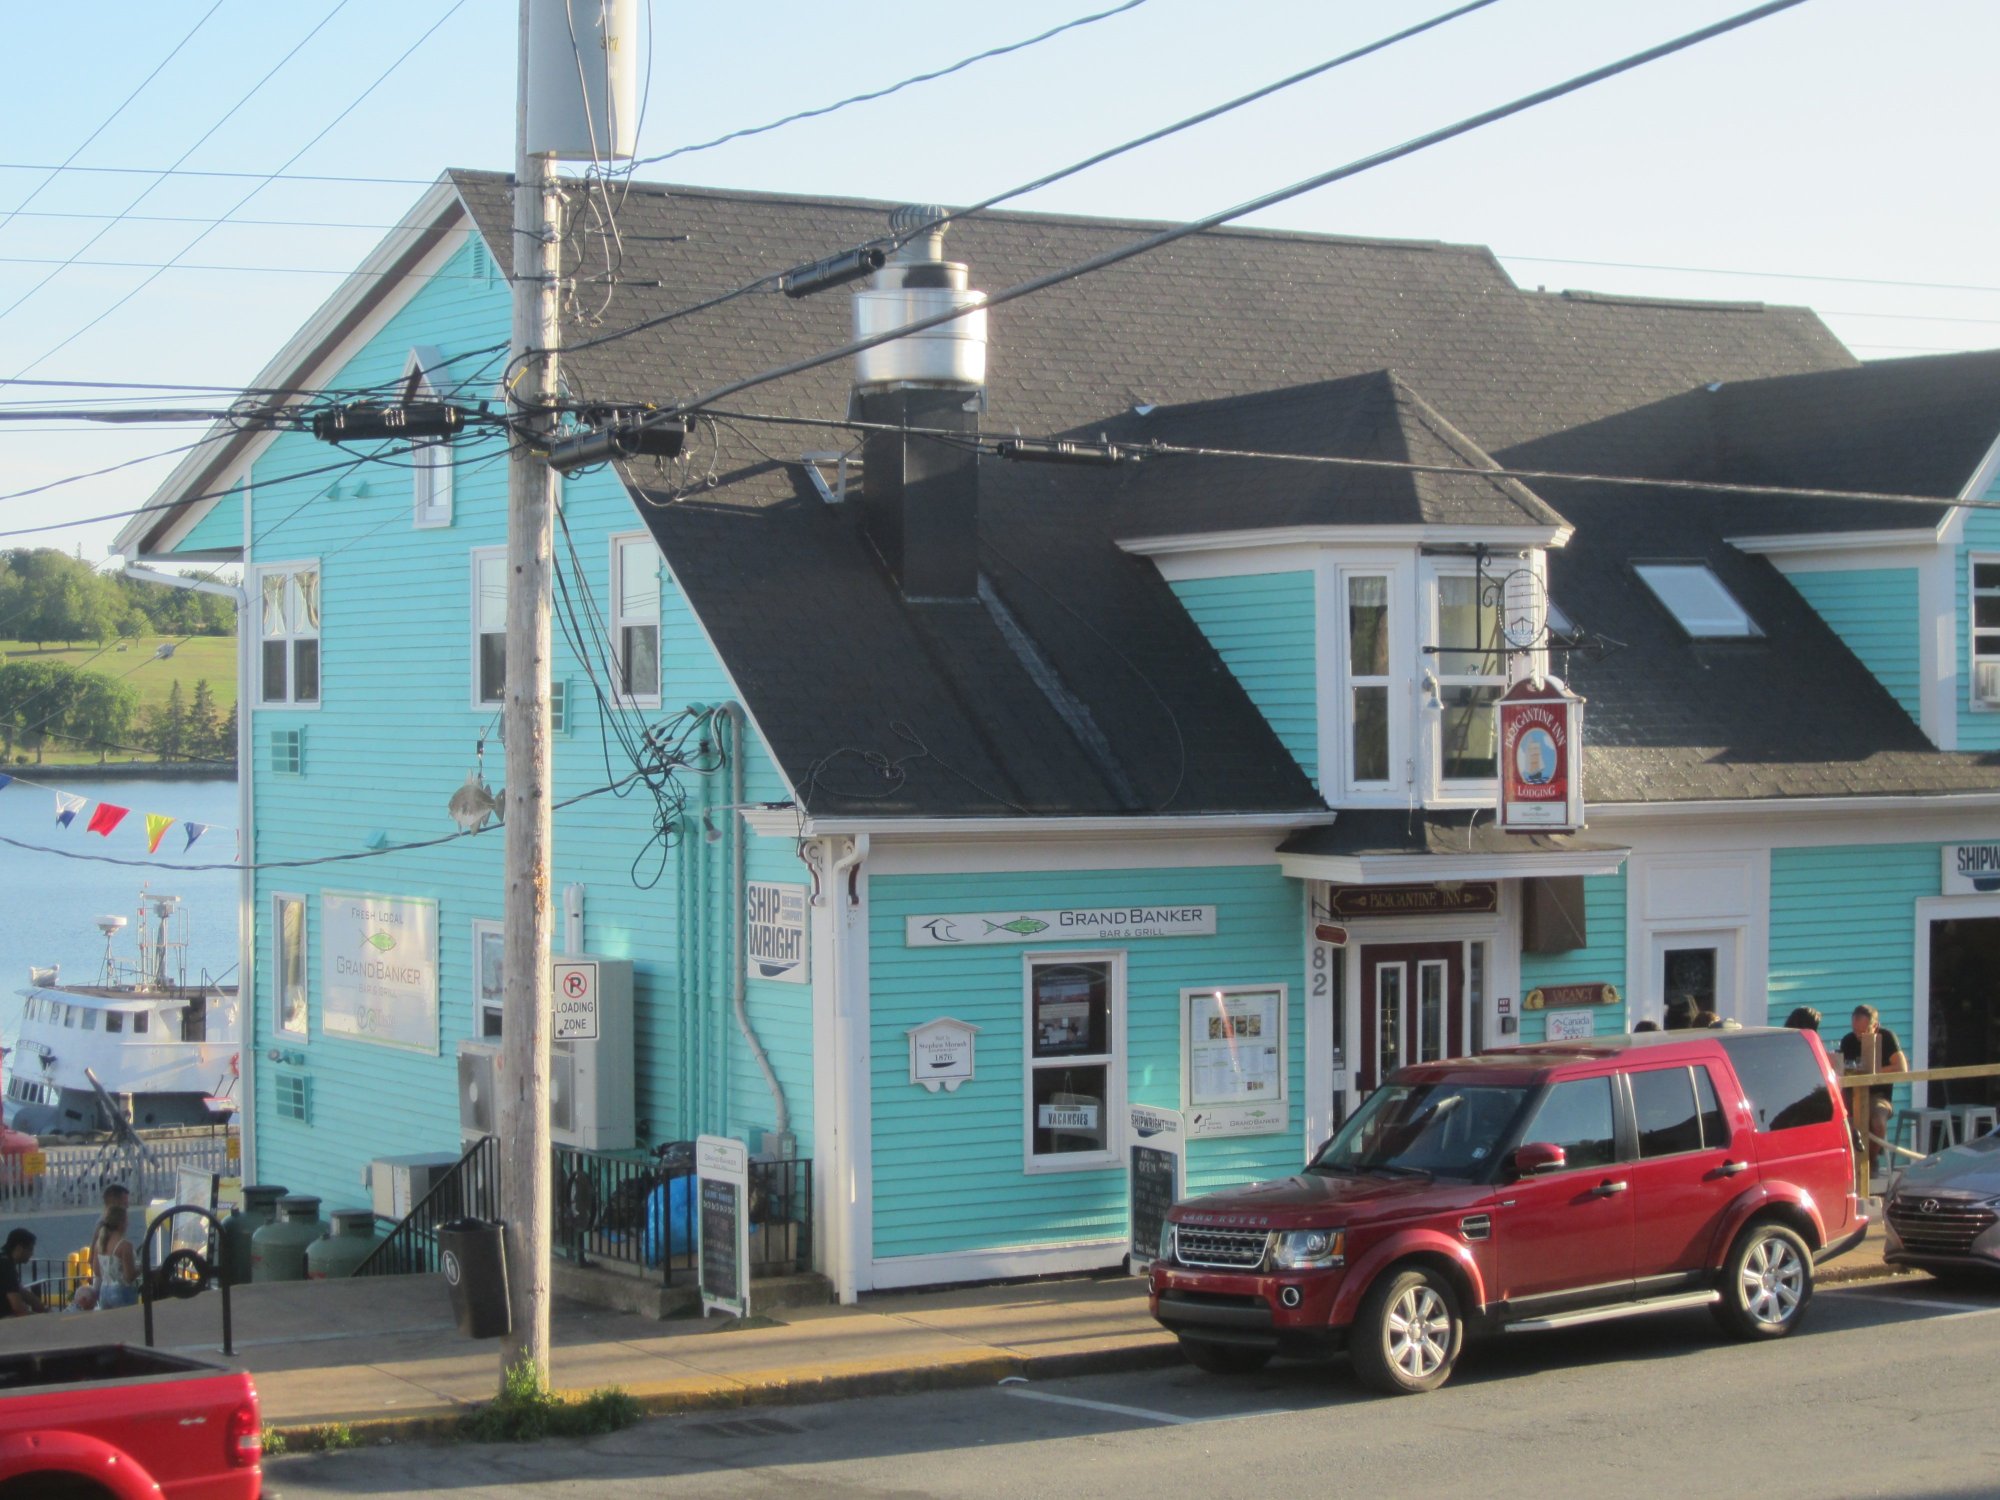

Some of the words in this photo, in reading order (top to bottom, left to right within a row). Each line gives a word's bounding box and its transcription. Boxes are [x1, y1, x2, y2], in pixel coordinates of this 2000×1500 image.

[1504, 707, 1555, 749] BRIGANTINE
[1551, 721, 1567, 747] INN
[1516, 784, 1556, 798] LODGING
[748, 885, 781, 925] SHIP
[1370, 891, 1438, 907] BRIGANTINE
[1443, 891, 1461, 906] INN
[351, 907, 376, 921] FRESH
[378, 910, 404, 925] LOCAL
[1099, 930, 1123, 938] BAR
[1124, 929, 1131, 937] &
[1134, 927, 1166, 937] GRILL
[748, 923, 803, 960] WRIGHT
[1551, 987, 1593, 1002] VACANCY
[556, 1001, 594, 1014] LOADING
[563, 1018, 588, 1030] ZONE
[1562, 1015, 1590, 1026] Canada
[1562, 1026, 1585, 1036] Select
[935, 1053, 953, 1061] 1876
[1047, 1112, 1089, 1126] VACANCIES
[1130, 1113, 1165, 1131] SHIPWRIGHT
[1182, 1212, 1213, 1222] LAND
[1218, 1215, 1268, 1225] ROVER
